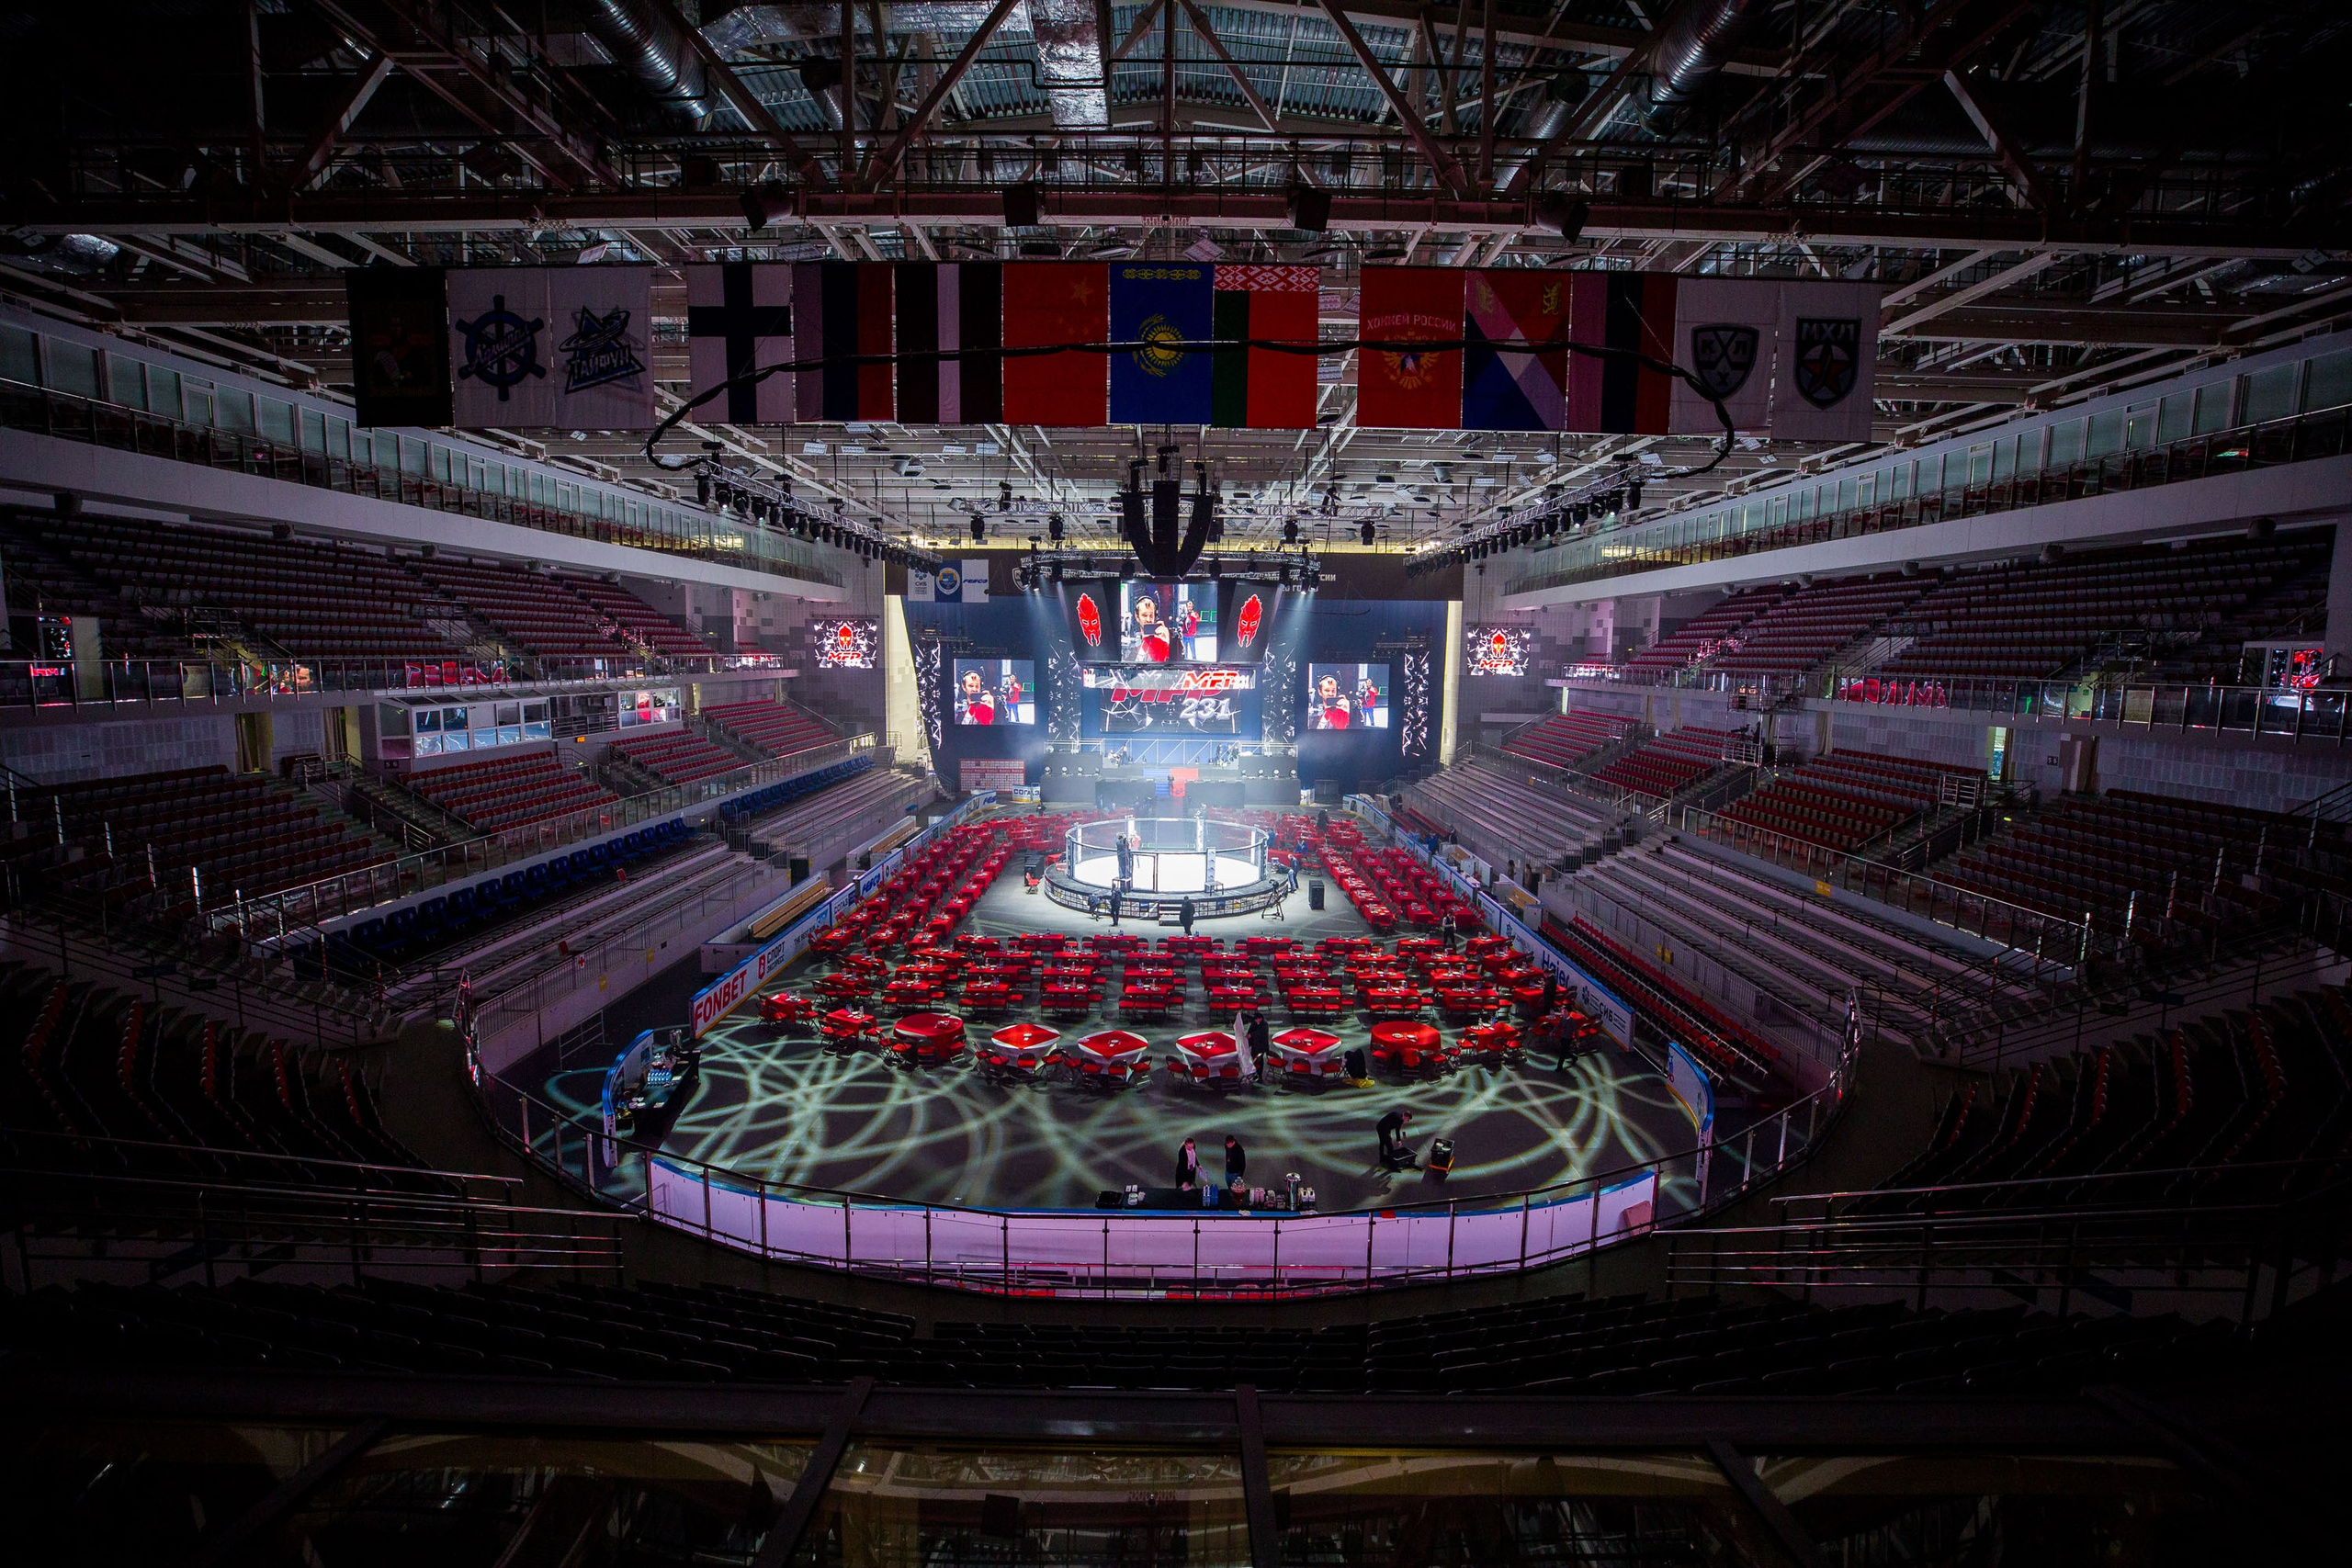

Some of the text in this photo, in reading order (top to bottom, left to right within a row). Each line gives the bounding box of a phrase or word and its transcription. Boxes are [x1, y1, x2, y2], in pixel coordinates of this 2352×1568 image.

[1366, 313, 1456, 333] ХОККЕЙ РОССИИ
[1802, 322, 1855, 341] МХЛ
[570, 345, 631, 380] ТАЙФУН
[827, 651, 862, 661] MFP
[1479, 660, 1514, 669] MFP
[1180, 698, 1230, 720] 231
[767, 941, 786, 964] СПОРТ
[695, 969, 747, 1030] FONBET
[1600, 1002, 1613, 1022] СИБ
